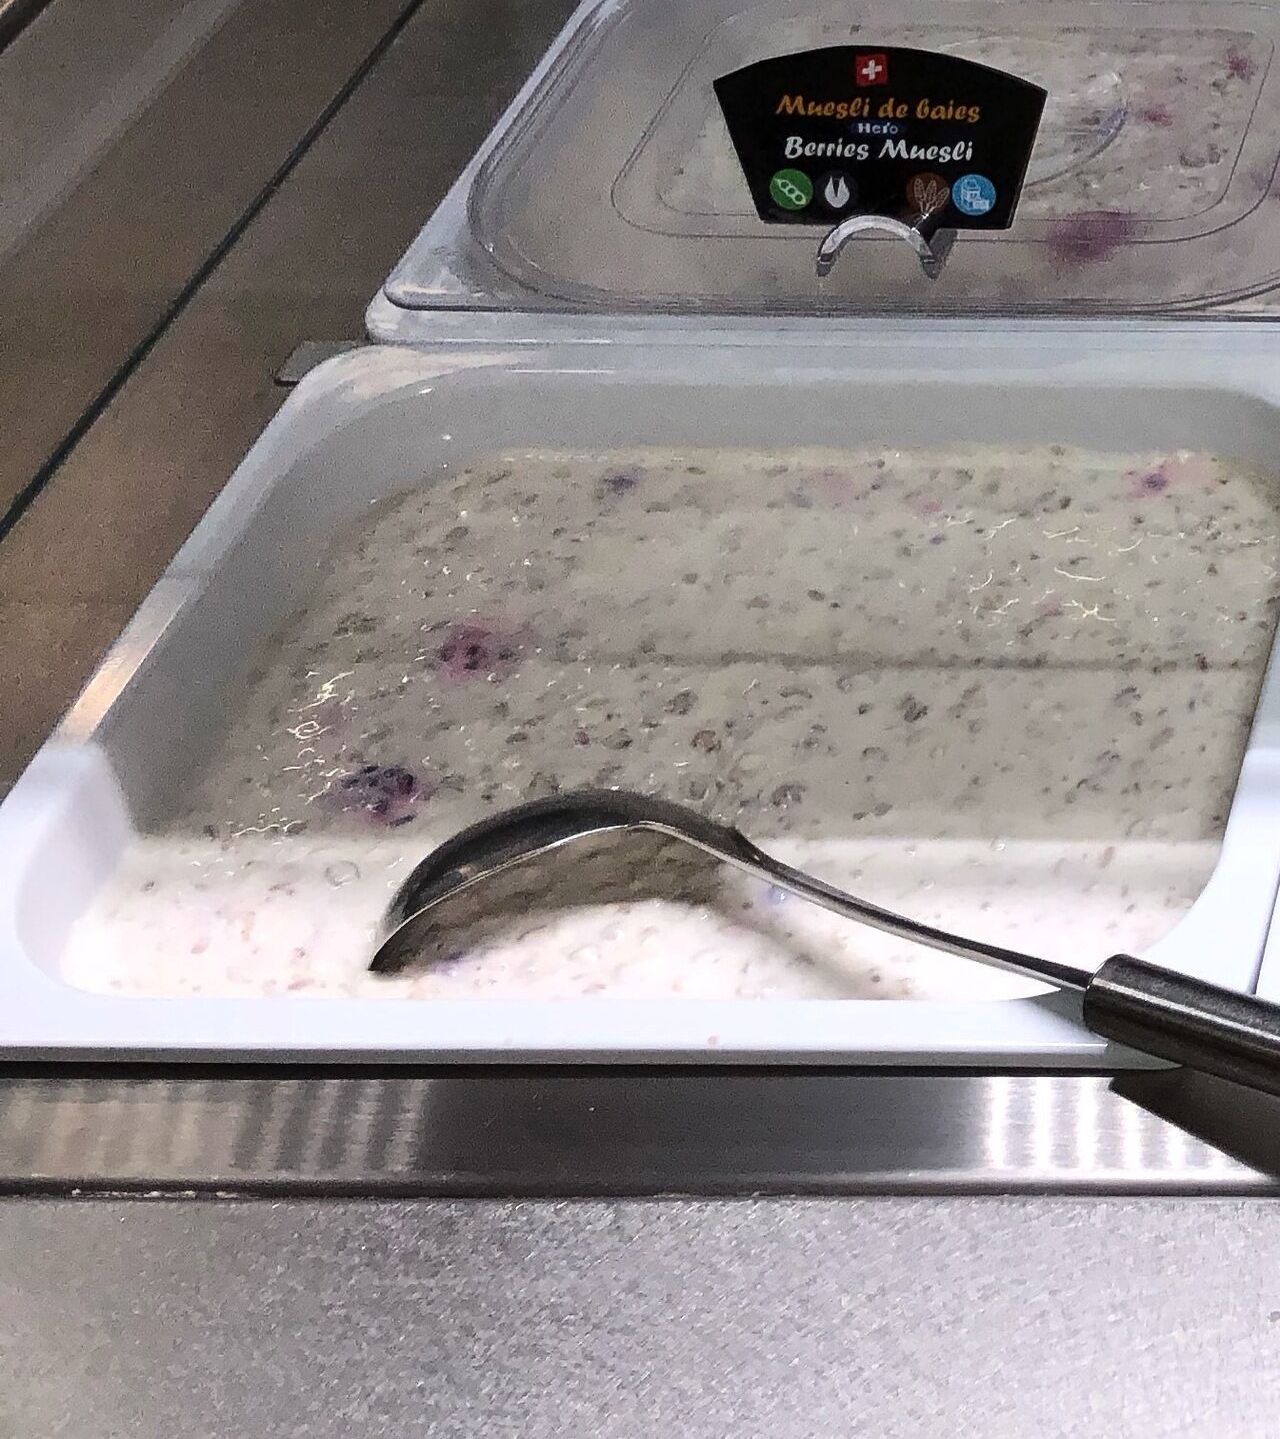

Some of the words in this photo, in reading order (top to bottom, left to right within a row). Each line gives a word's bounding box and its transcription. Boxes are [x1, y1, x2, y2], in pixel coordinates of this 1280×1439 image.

[775, 94, 871, 118] Muesli
[878, 97, 909, 119] de
[916, 98, 981, 123] baies
[784, 136, 870, 160] Berries
[878, 139, 974, 163] Muesli
